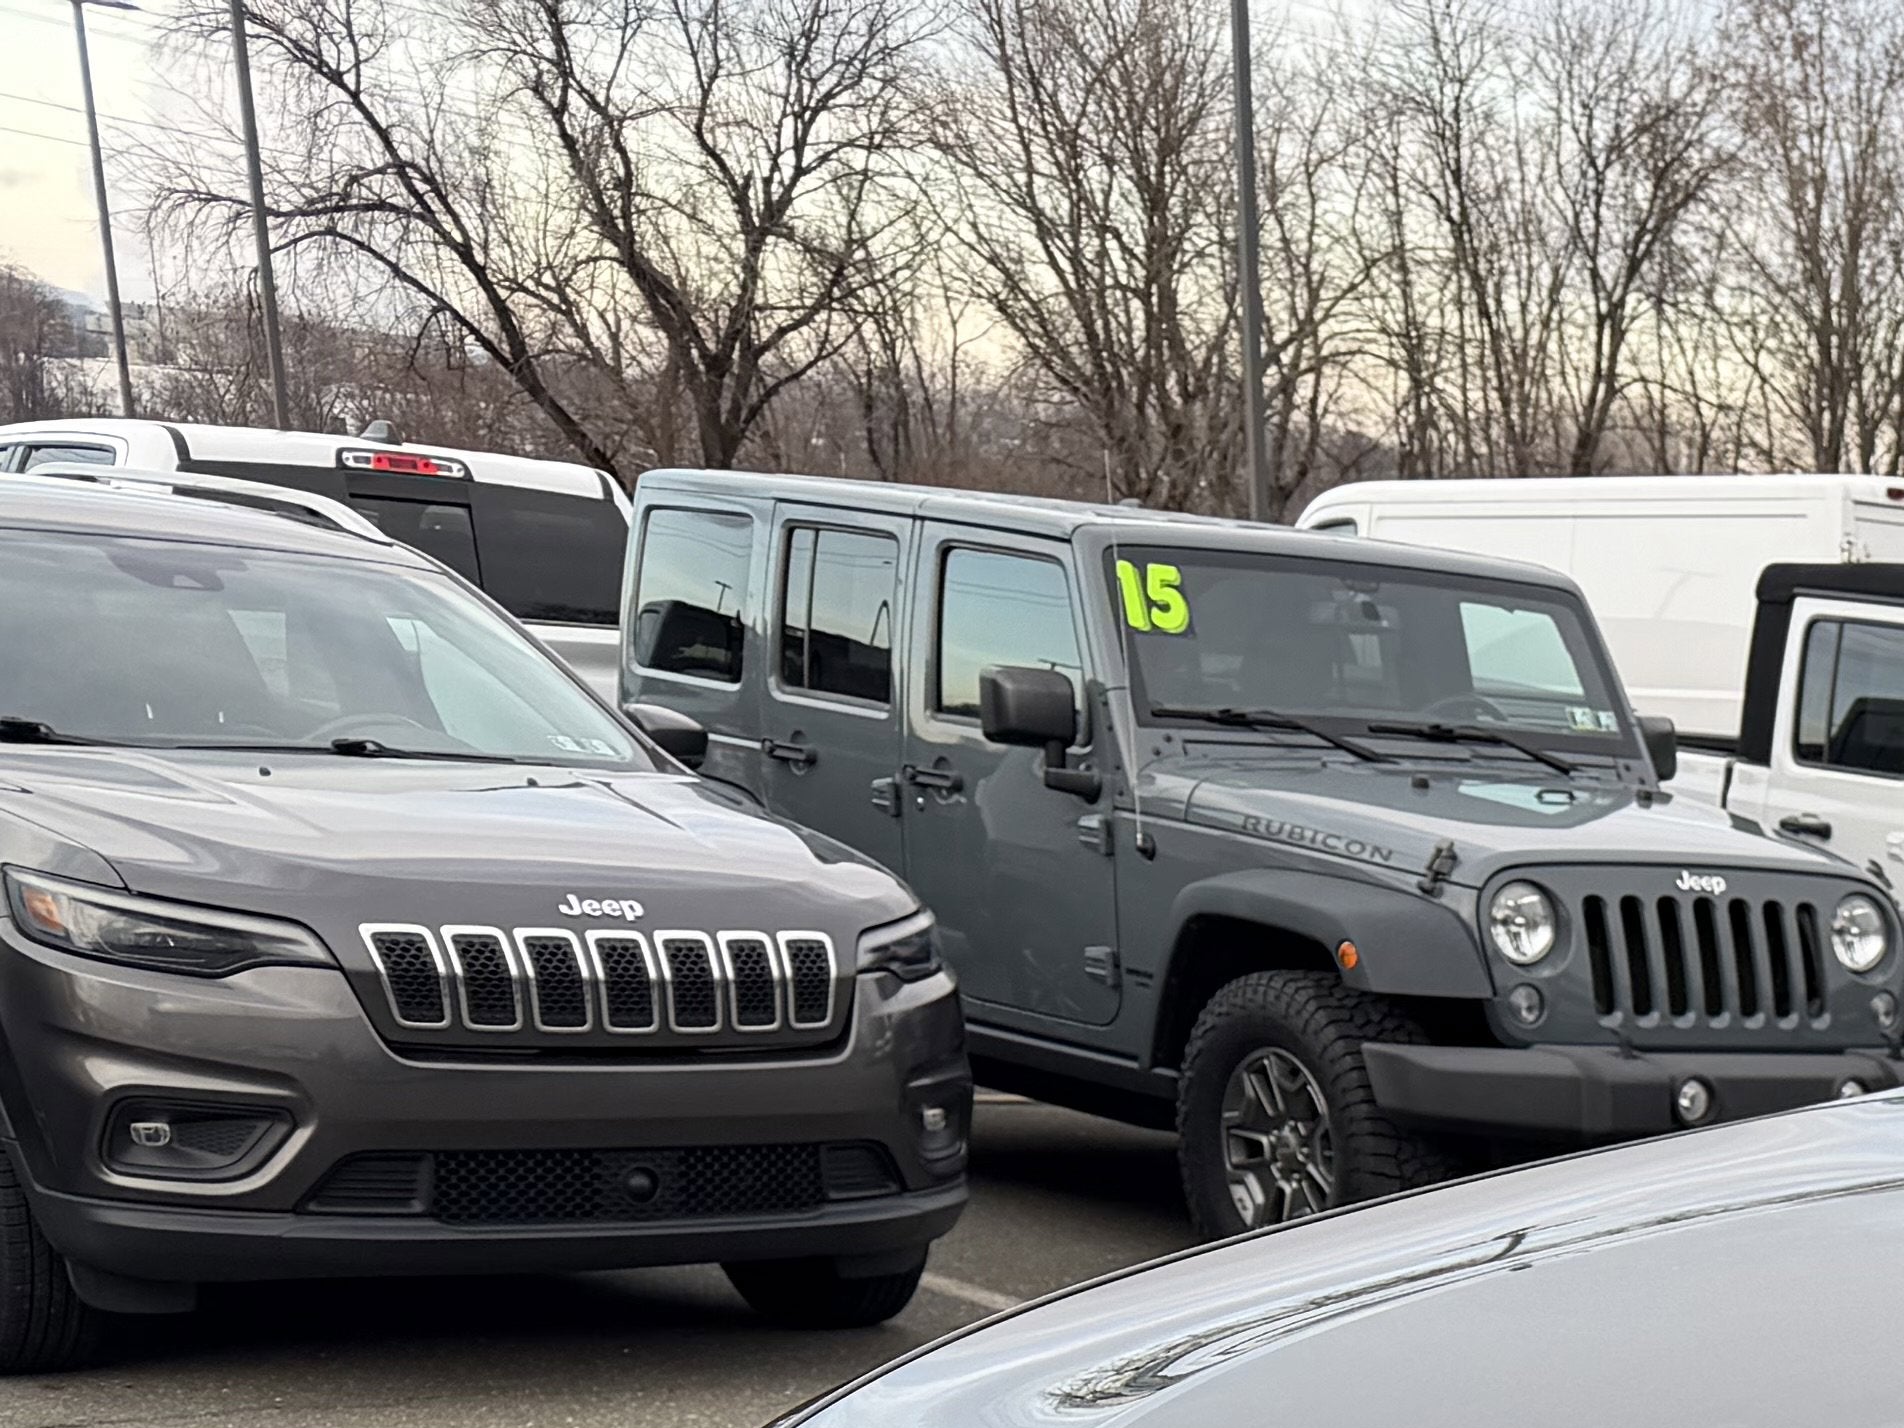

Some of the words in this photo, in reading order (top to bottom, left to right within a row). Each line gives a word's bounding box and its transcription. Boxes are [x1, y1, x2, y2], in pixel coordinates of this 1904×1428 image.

[1116, 559, 1190, 634] 15
[1241, 815, 1394, 862] RUBICON
[1676, 870, 1727, 895] Jeep
[558, 894, 644, 921] Jeep
